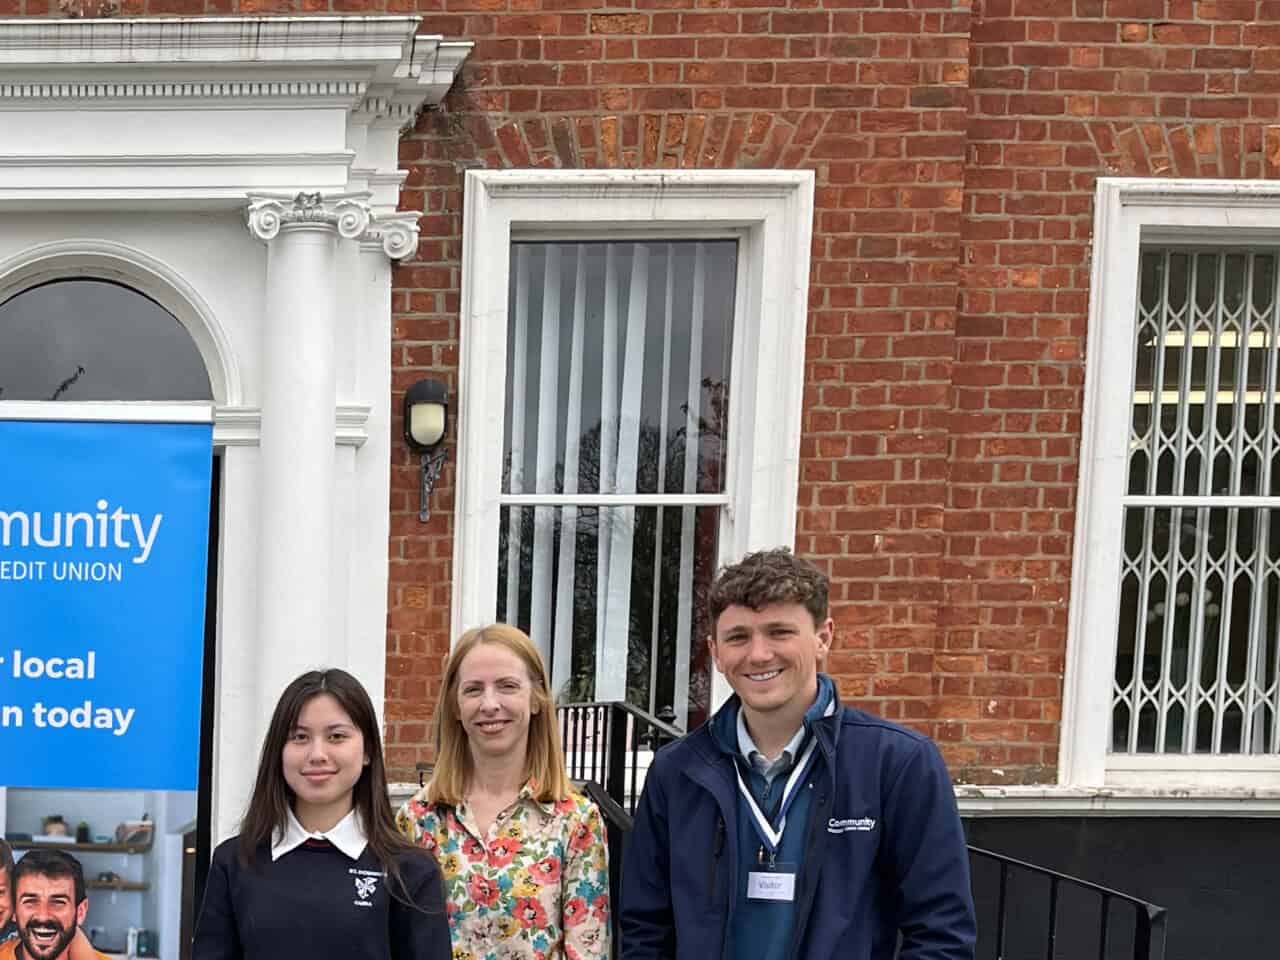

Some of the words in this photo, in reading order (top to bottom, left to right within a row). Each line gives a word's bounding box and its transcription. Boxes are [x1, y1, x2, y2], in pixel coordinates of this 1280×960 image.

[53, 561, 122, 581] UNION
[13, 650, 96, 679] local
[32, 701, 135, 735] today
